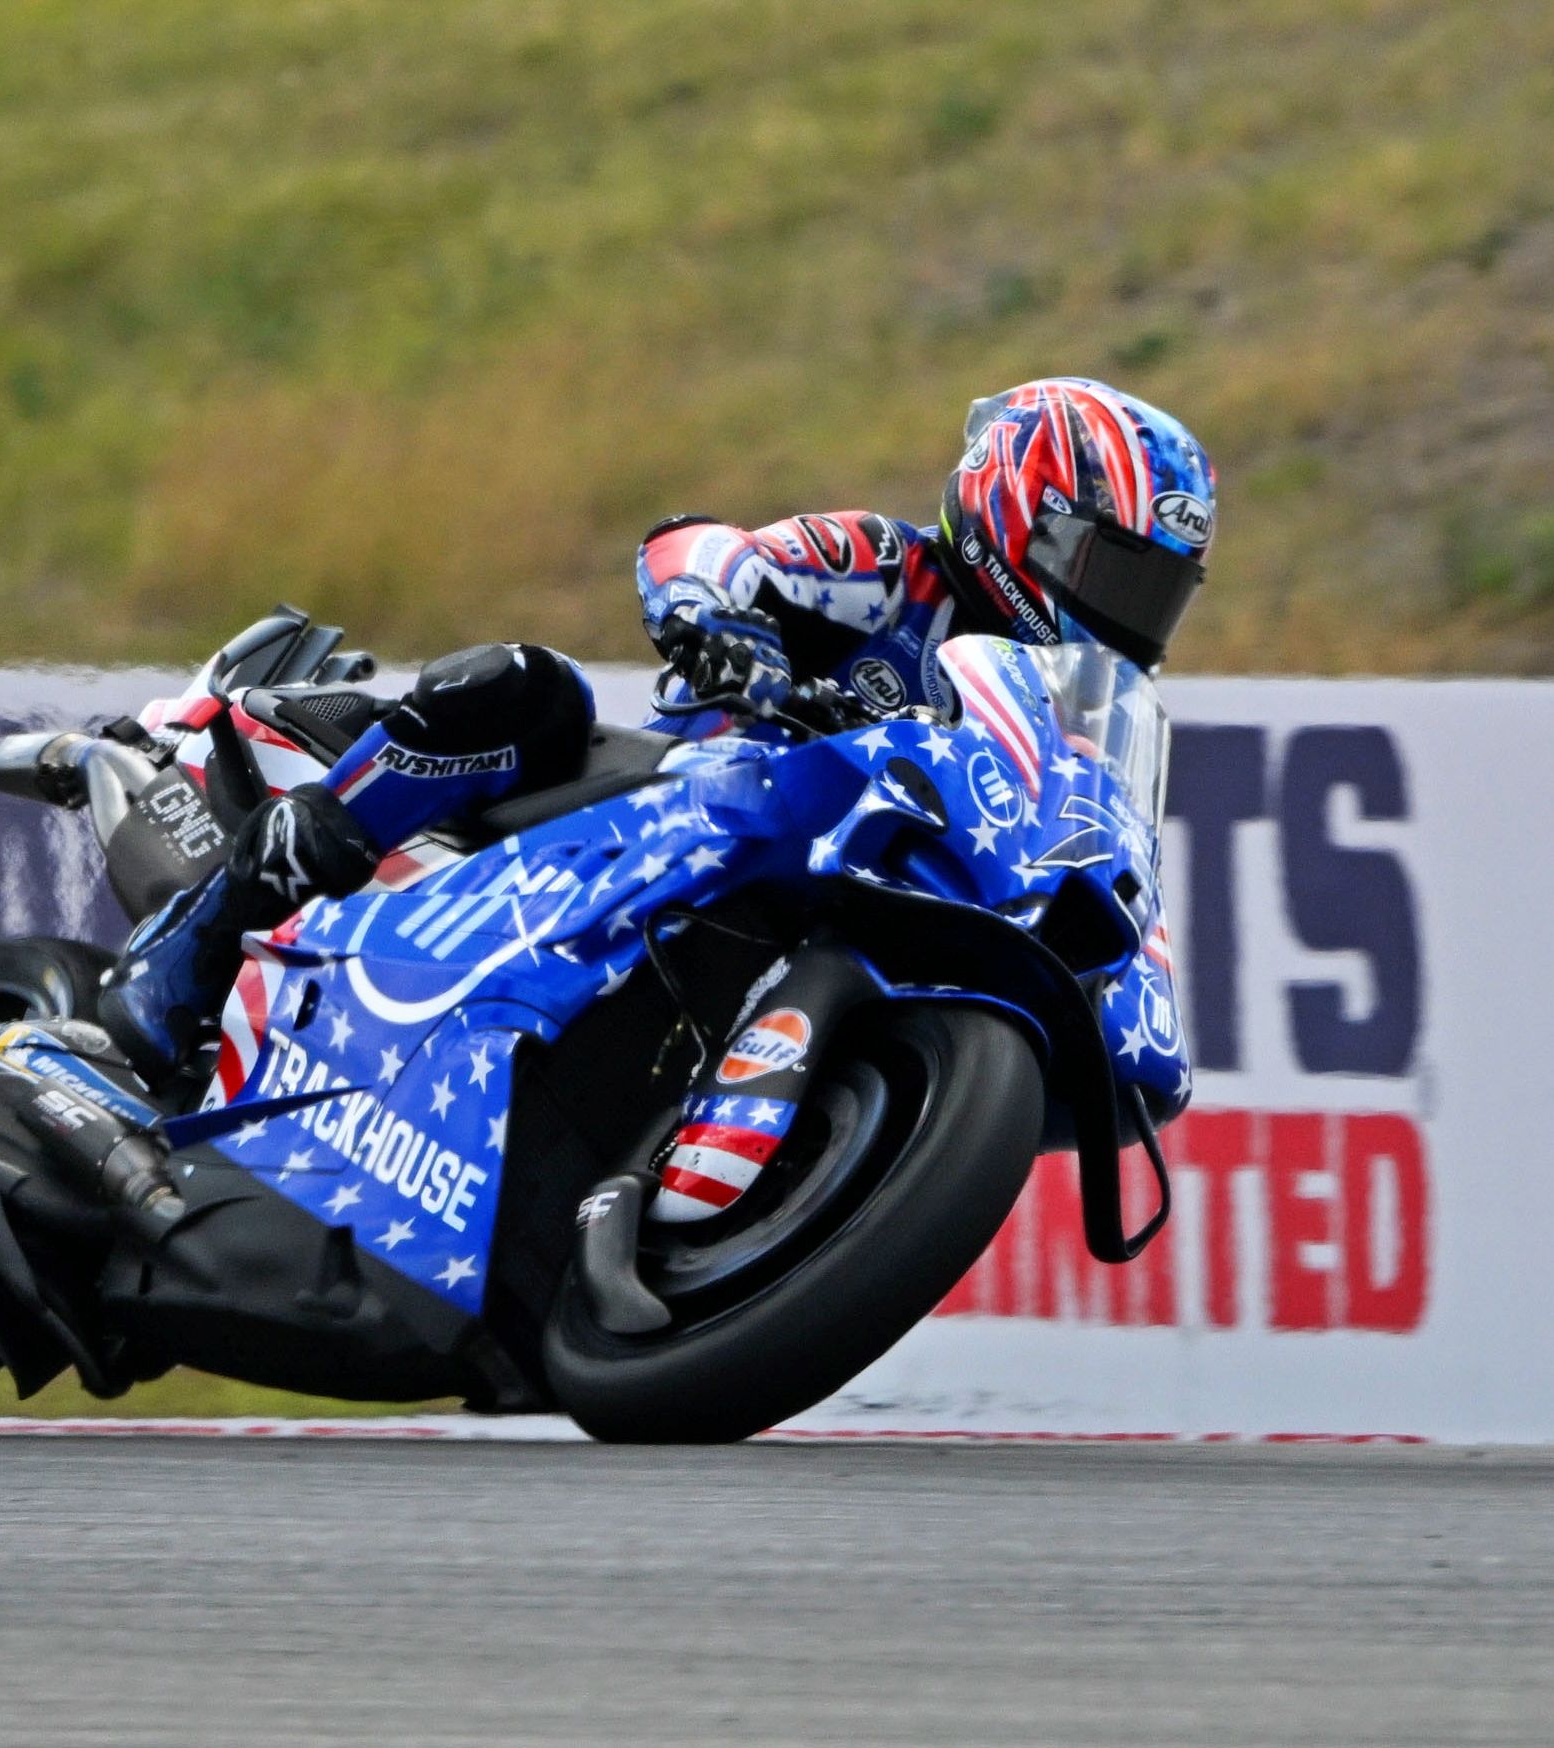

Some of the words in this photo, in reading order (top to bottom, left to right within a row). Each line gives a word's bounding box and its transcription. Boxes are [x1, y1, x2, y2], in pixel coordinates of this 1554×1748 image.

[984, 553, 1059, 646] TRACKHOUSE
[149, 781, 225, 859] GNG
[732, 1031, 798, 1063] Gulf
[257, 1027, 488, 1233] TRACKHOUSE
